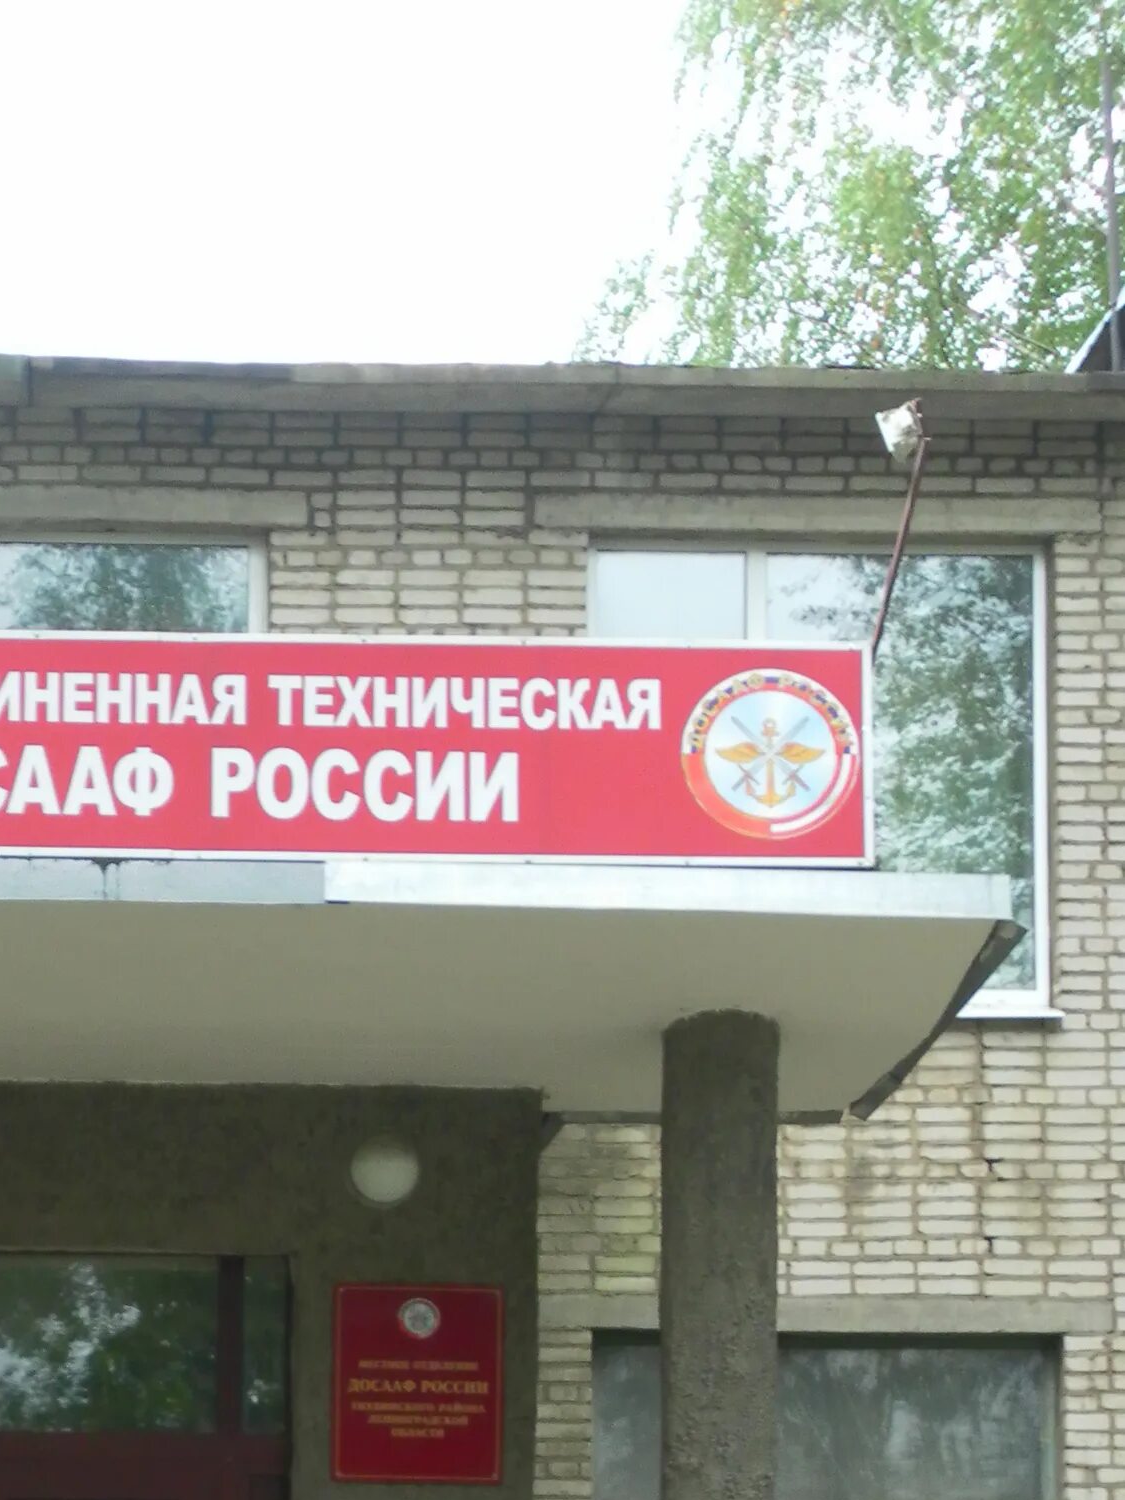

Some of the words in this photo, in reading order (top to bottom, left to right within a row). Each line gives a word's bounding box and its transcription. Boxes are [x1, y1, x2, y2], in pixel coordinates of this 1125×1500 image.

[267, 674, 662, 731] ТЕХНИЧЕСКАЯ
[210, 747, 520, 823] РОССИИ
[347, 1377, 417, 1393] ДОСААФ
[420, 1379, 490, 1394] РОССИИ
